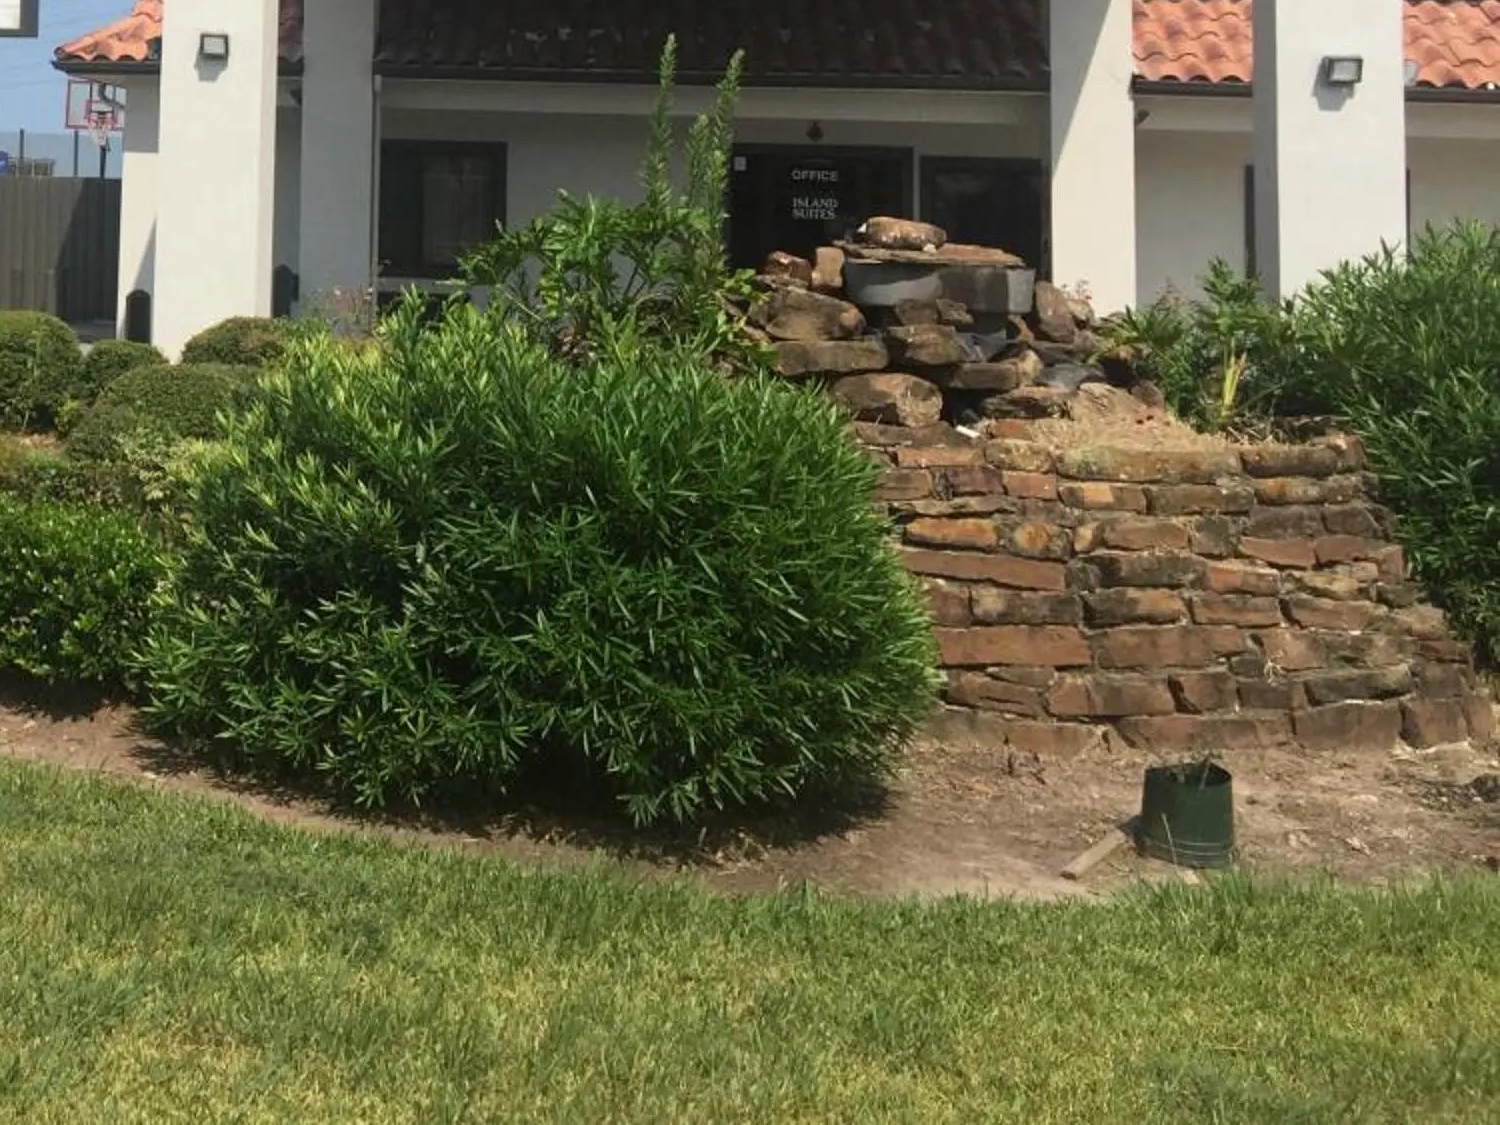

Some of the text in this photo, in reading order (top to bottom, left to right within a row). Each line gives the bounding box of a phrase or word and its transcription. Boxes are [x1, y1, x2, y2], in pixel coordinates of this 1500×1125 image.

[791, 170, 839, 181] OFFICE
[793, 197, 838, 208] ISLAND
[793, 208, 837, 220] SUITES
